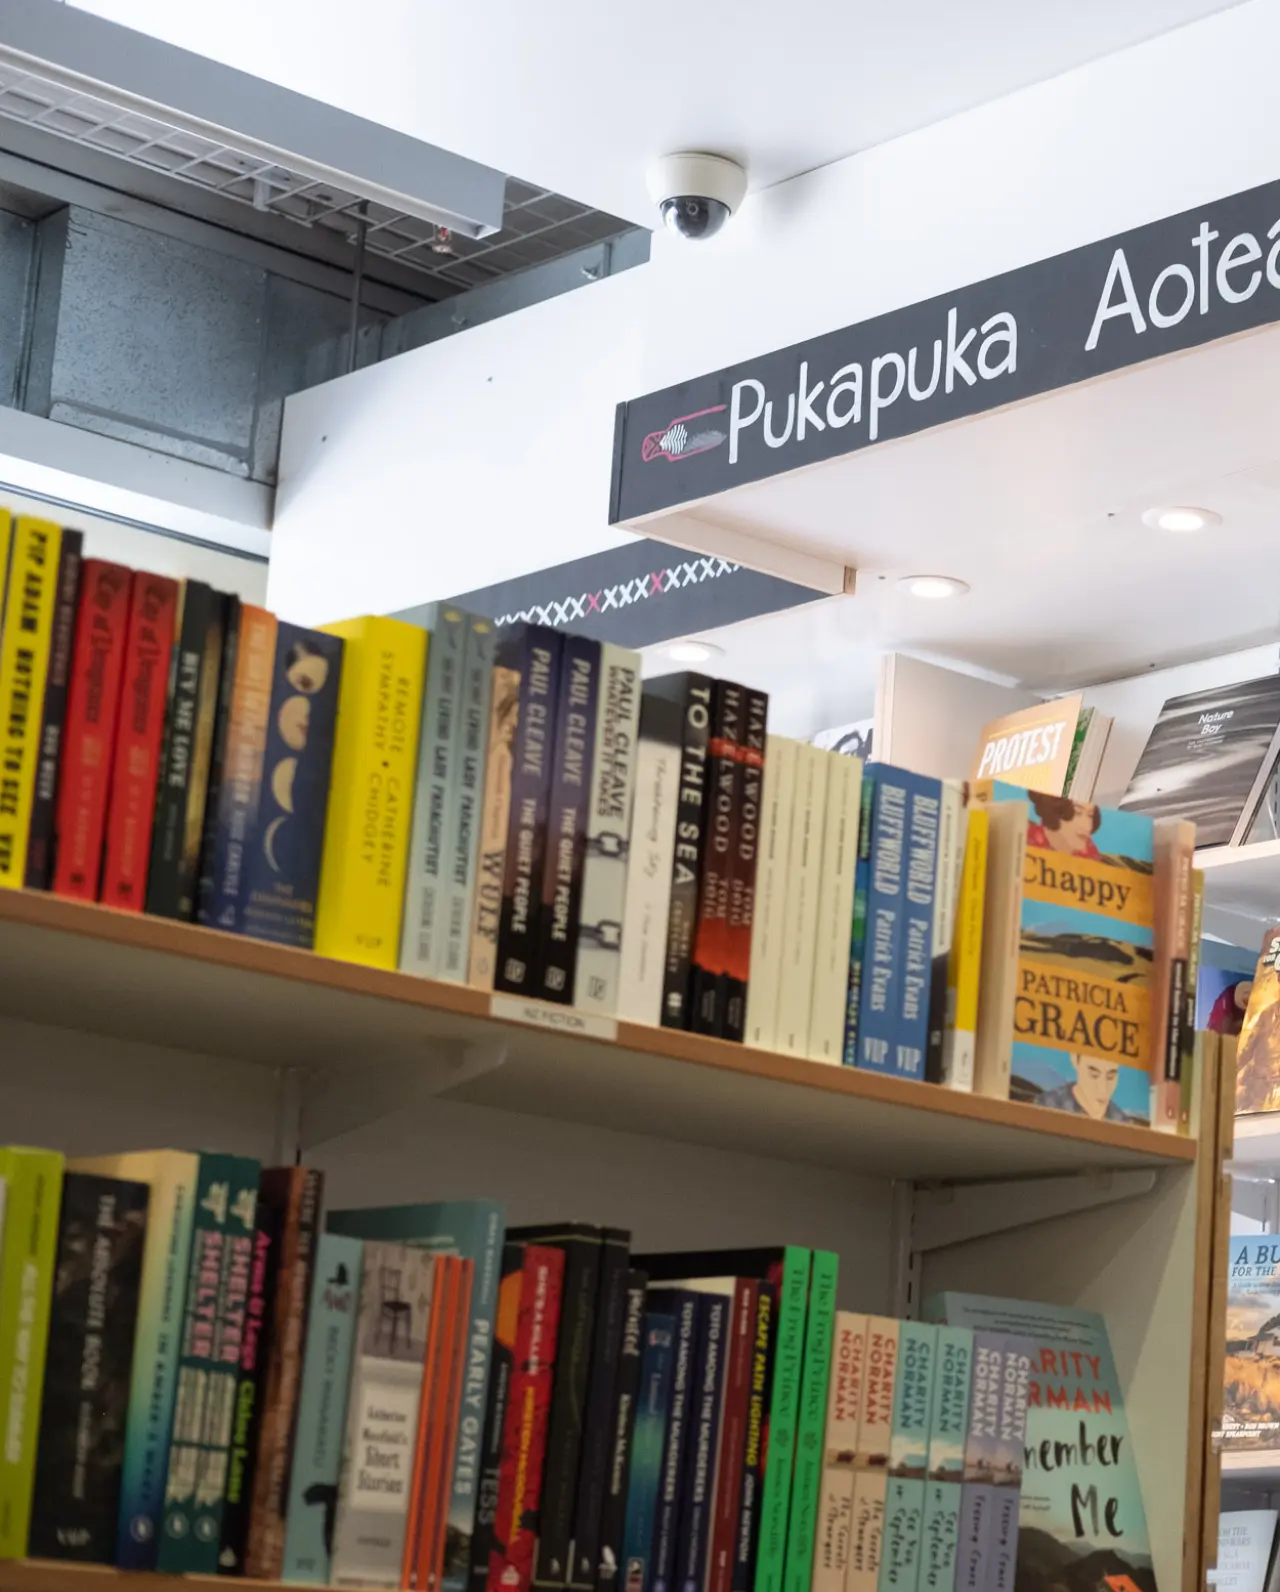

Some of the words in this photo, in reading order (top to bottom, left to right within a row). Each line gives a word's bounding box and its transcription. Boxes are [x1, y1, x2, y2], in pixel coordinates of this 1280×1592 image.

[728, 309, 1019, 464] Pukapuka
[30, 528, 47, 569] PIP
[19, 572, 43, 634] ADAM
[7, 649, 35, 739] NOTHING
[531, 647, 551, 697] PAUL
[617, 667, 636, 721] PAUL
[176, 698, 195, 734] ME
[373, 649, 393, 754] SYMPATHY
[686, 687, 711, 731] TO
[1198, 709, 1234, 725] Nature
[1200, 722, 1222, 734] Boy
[3, 745, 24, 772] TO
[169, 734, 191, 789] LOVE
[522, 702, 548, 779] CLEAVE
[977, 721, 1067, 779] PROTEST
[0, 777, 20, 819] SEE
[609, 729, 632, 824] CLEAVE
[681, 742, 707, 808] THE
[713, 687, 742, 854] HAZELWOOD
[738, 697, 765, 862] HAZELWOOD
[360, 771, 383, 865] CHIDGEY
[376, 776, 399, 889] CATHERINE
[521, 799, 536, 824] THE
[874, 783, 906, 897] BLUFFWORLD
[518, 826, 534, 872] QUIET
[673, 818, 701, 888] SEA
[906, 794, 939, 906] BLUFFWORLD
[476, 848, 504, 946] WULF
[510, 872, 531, 935] PEOPLE
[1022, 853, 1132, 911] Chappy
[874, 908, 896, 960] Patrick
[906, 918, 929, 971] Patrick
[870, 959, 893, 1012] Evans
[902, 970, 926, 1021] Evans
[1021, 969, 1129, 1014] PATRICIA
[1013, 996, 1140, 1059] GRACE
[1231, 1266, 1252, 1277] FOR
[1254, 1266, 1276, 1277] THE
[1235, 1250, 1249, 1264] A
[190, 1229, 223, 1358] SHELTER
[220, 1235, 252, 1365] SHELTER
[708, 1303, 722, 1340] TOTO
[755, 1294, 771, 1350] ESCAPE
[466, 1318, 490, 1410] PEARLY
[703, 1344, 719, 1393] AMONG
[751, 1353, 766, 1394] PATH
[865, 1333, 884, 1426] NORMAN
[877, 1337, 897, 1427] CHARITY
[701, 1396, 713, 1420] THE
[999, 1352, 1019, 1441] NORMAN
[1012, 1355, 1031, 1441] CHARITY
[453, 1416, 479, 1497] GATES
[746, 1396, 763, 1467] LIGHTING
[1071, 1483, 1124, 1538] Me
